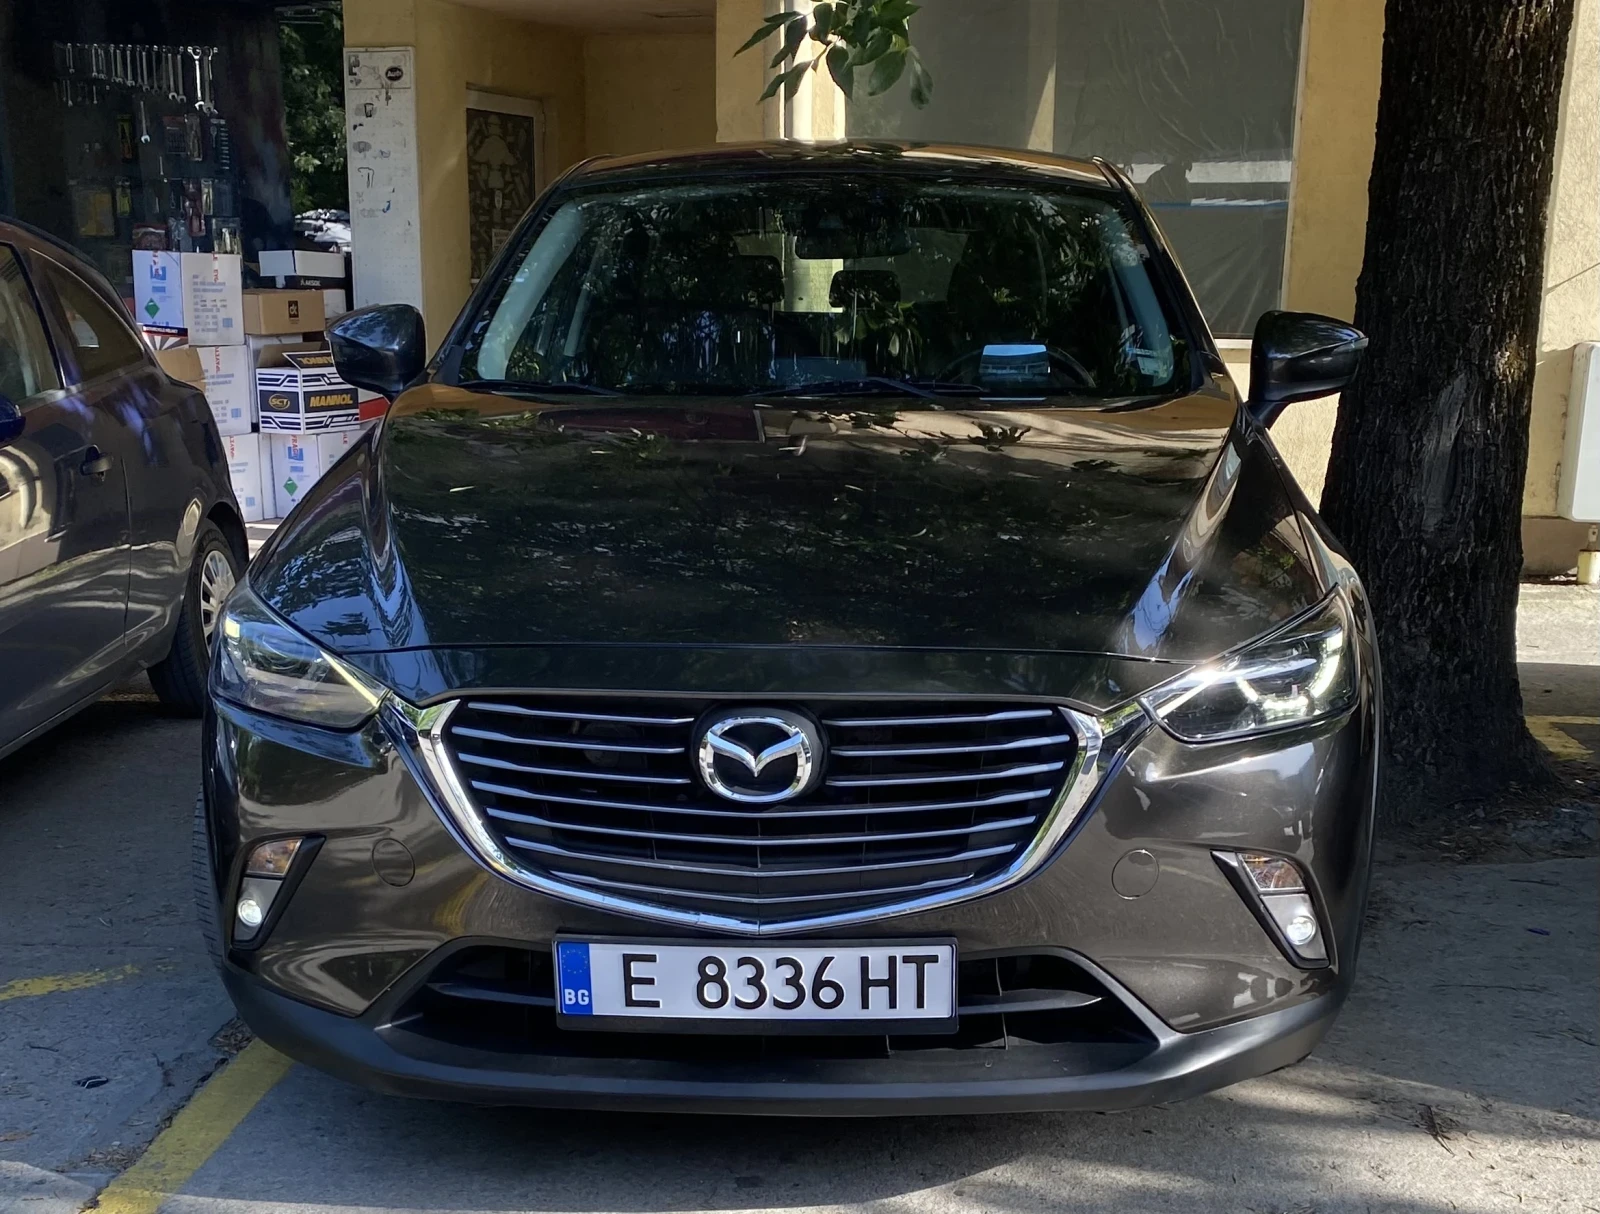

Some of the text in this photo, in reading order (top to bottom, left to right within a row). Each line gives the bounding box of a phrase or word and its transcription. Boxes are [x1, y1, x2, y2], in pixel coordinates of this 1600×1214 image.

[310, 394, 353, 408] MANNOL
[623, 953, 939, 1010] E 8336 HT
[565, 988, 590, 1005] BG
